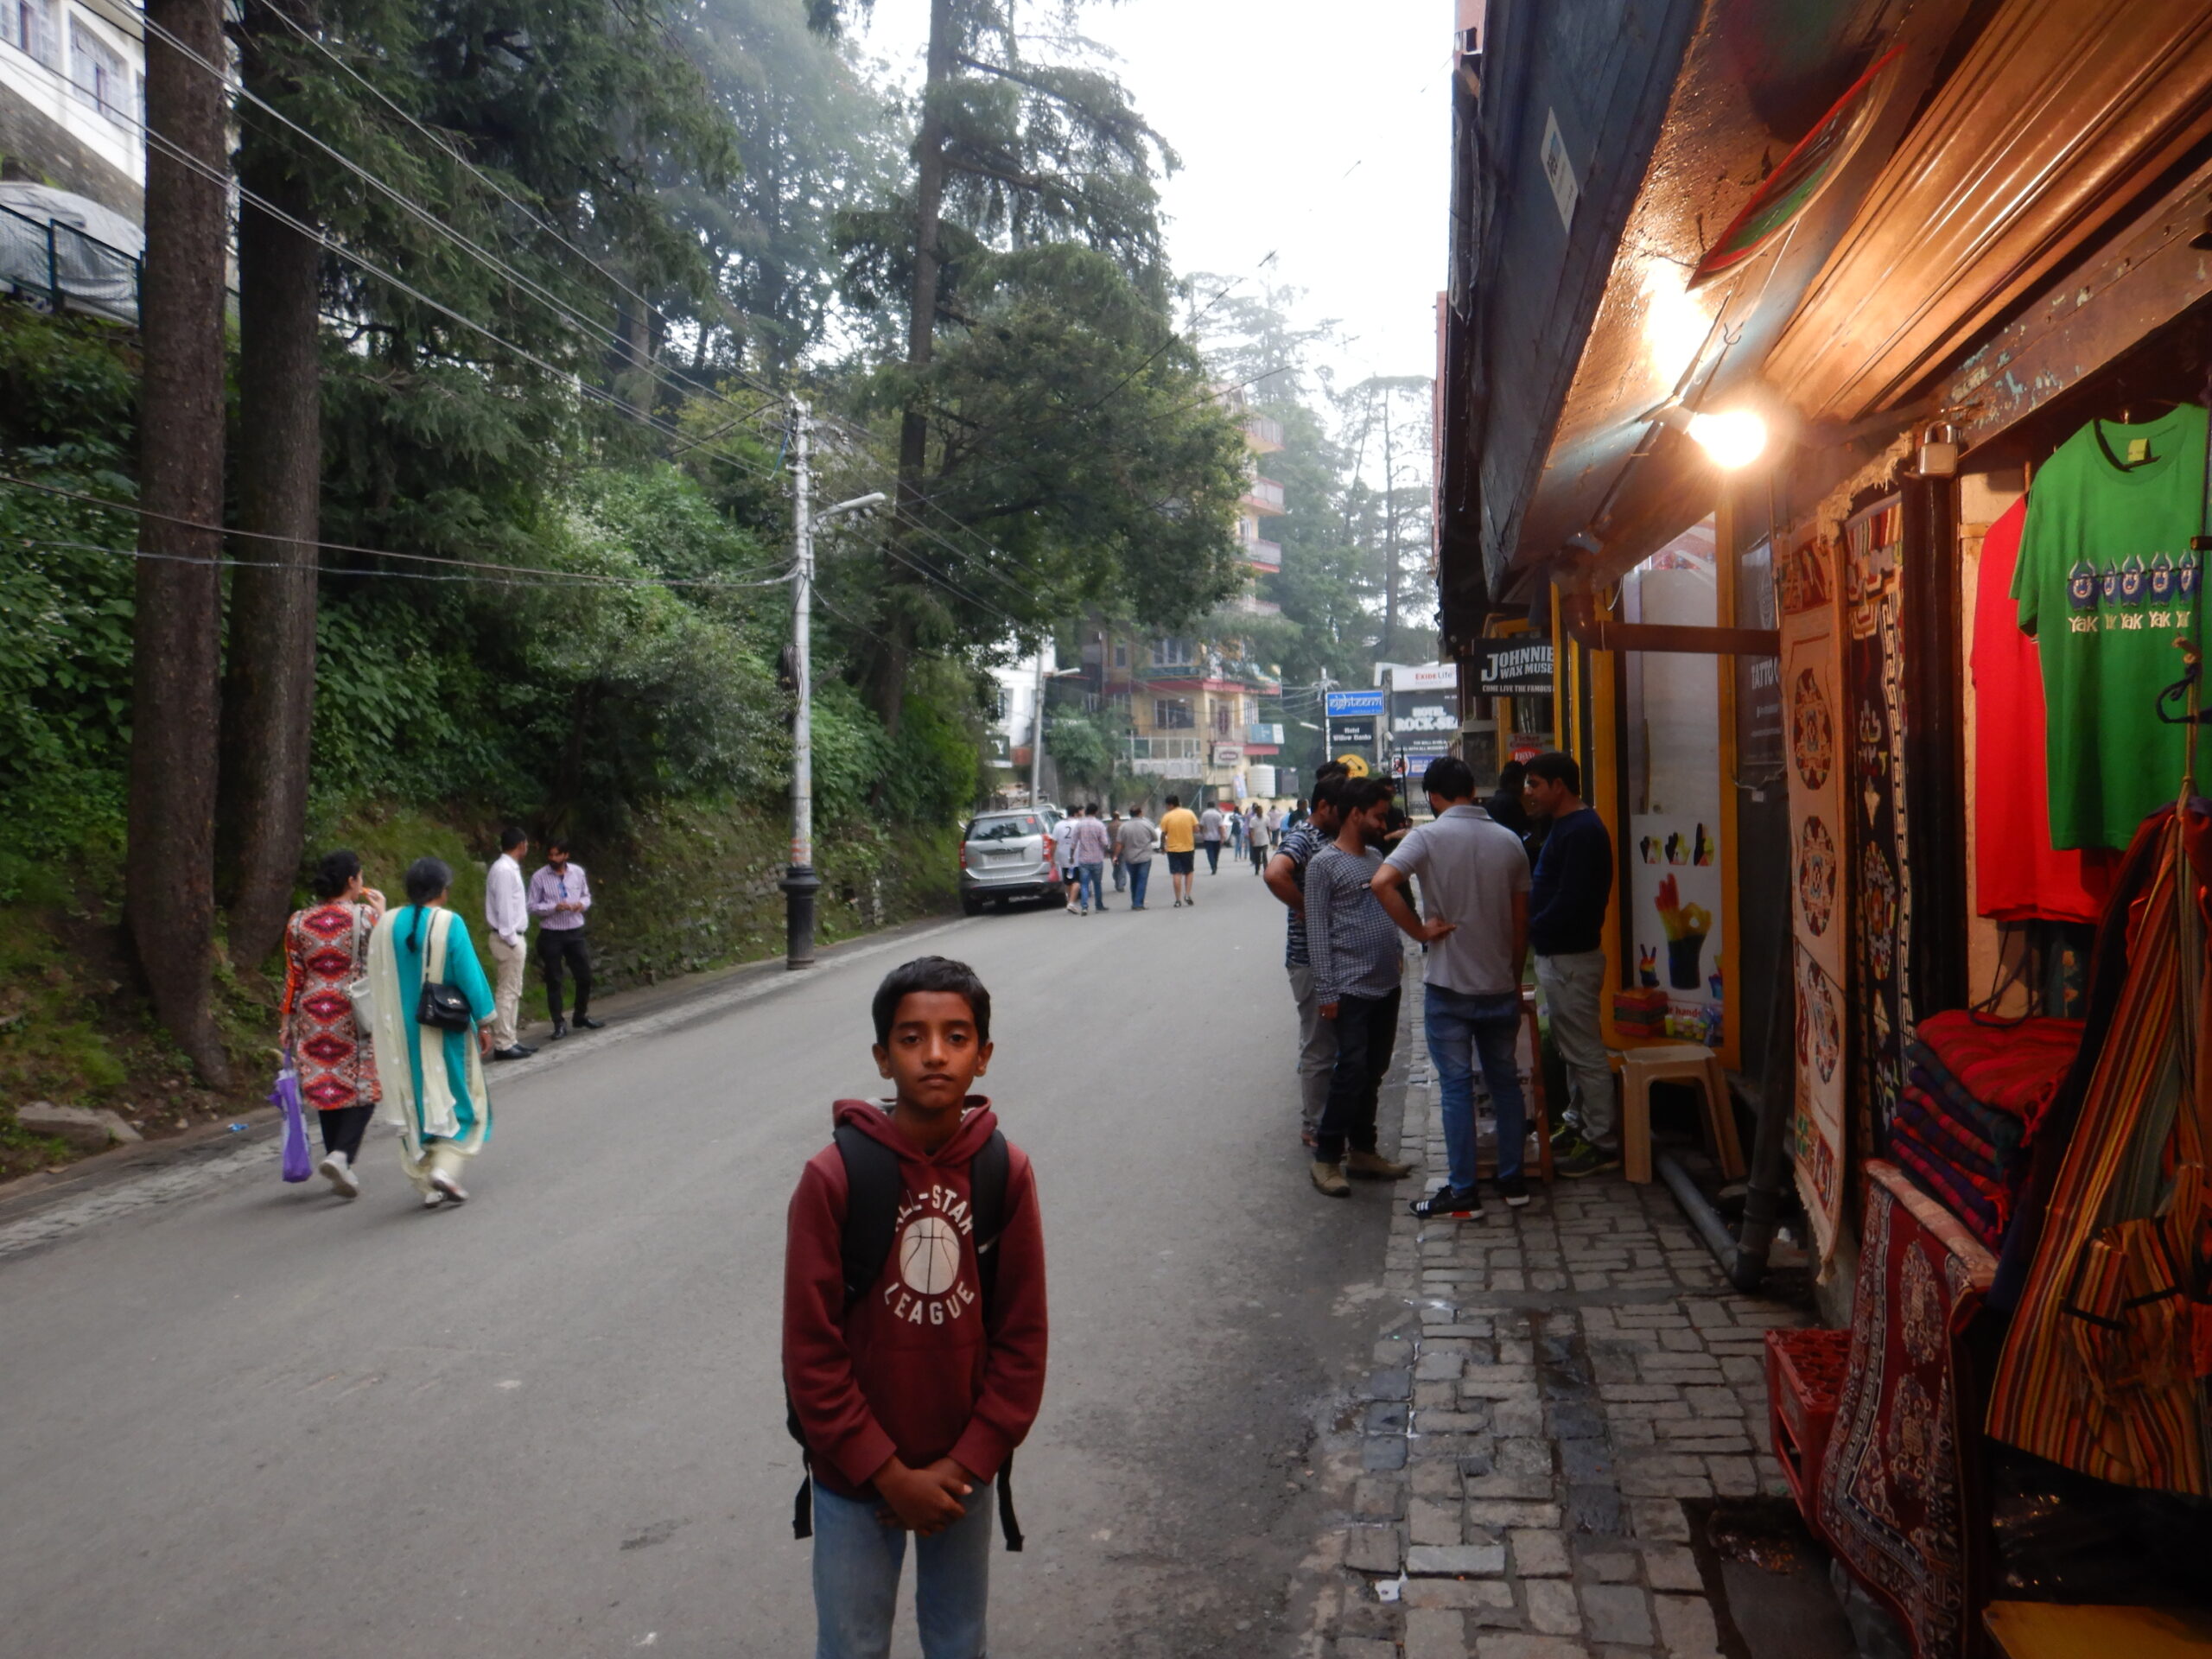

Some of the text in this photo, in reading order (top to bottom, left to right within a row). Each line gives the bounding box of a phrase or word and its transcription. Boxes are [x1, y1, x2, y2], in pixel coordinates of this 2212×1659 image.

[1500, 665, 1523, 679] WAX
[1527, 684, 1552, 693] FAMOUS
[1064, 826, 1071, 839] 2
[883, 1281, 976, 1325] LEAGUE
